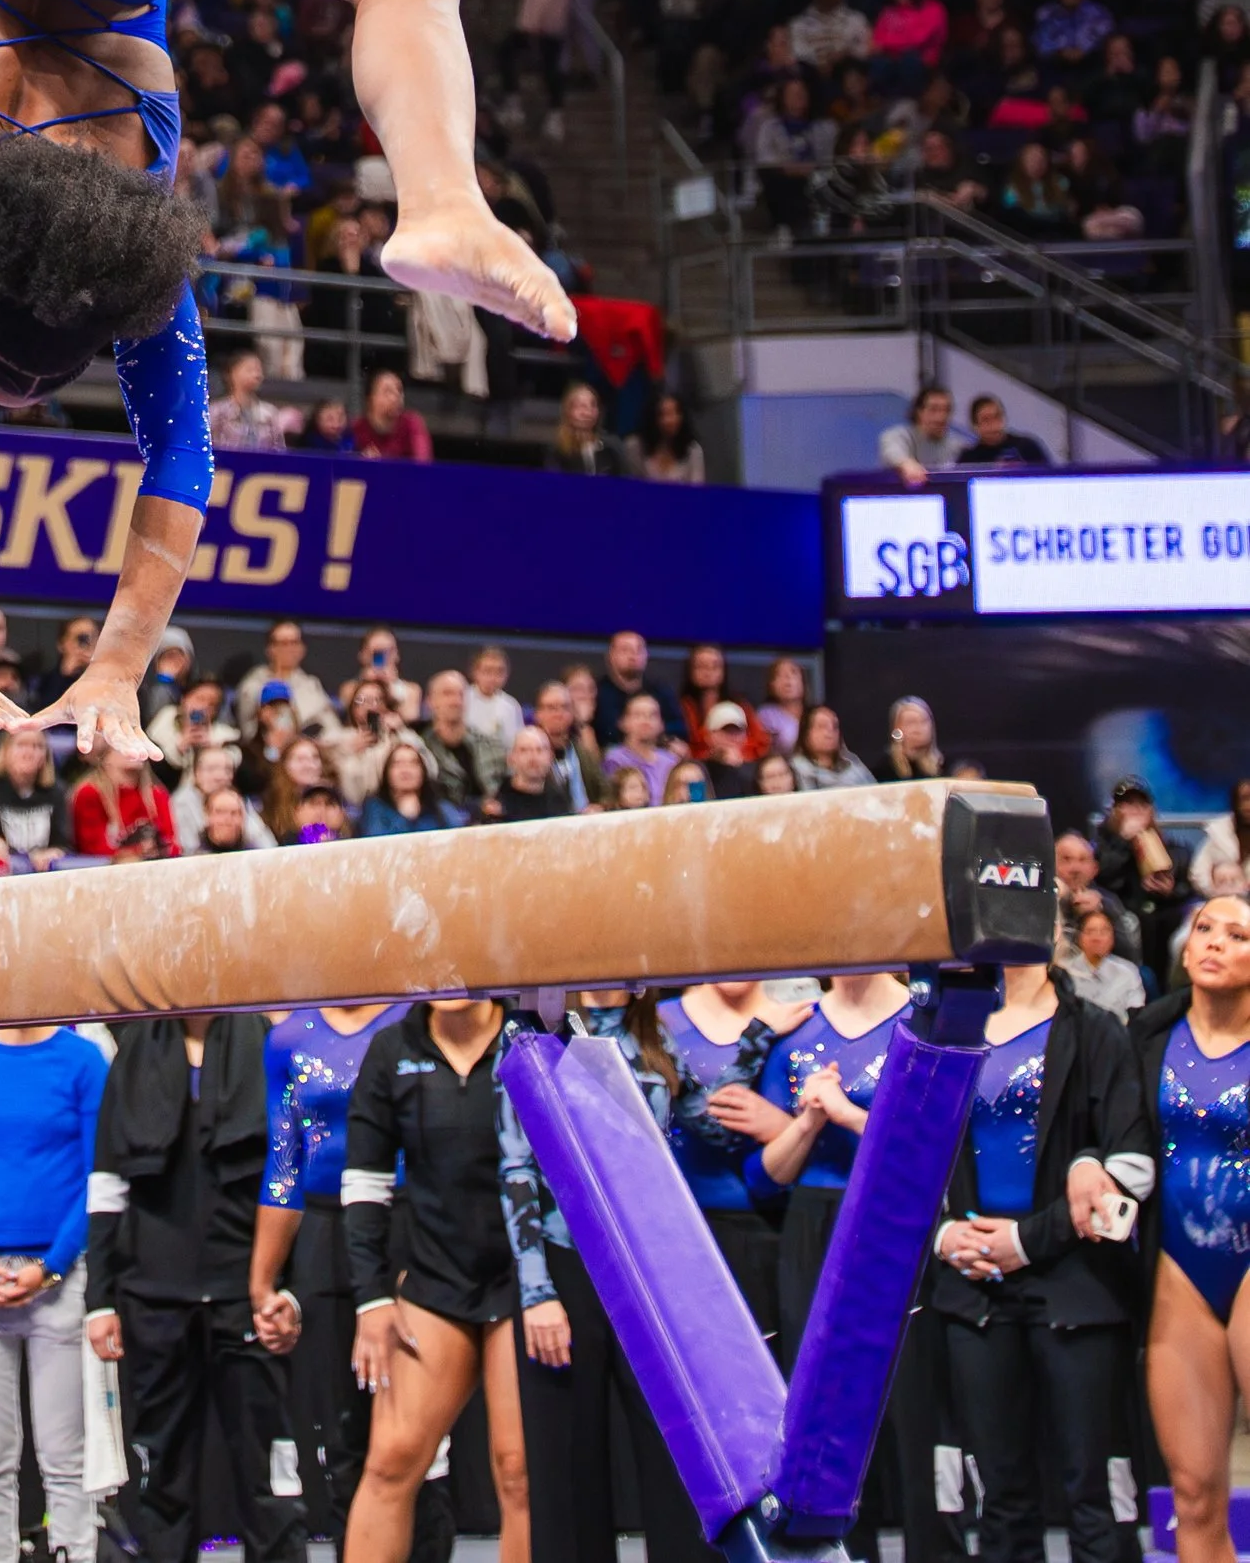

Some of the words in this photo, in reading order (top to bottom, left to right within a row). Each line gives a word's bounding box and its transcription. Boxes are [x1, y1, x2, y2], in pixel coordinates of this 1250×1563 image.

[989, 523, 1183, 563] SCHROETER
[1202, 523, 1250, 560] GO
[877, 534, 970, 593] SGB
[979, 864, 1040, 887] AAI
